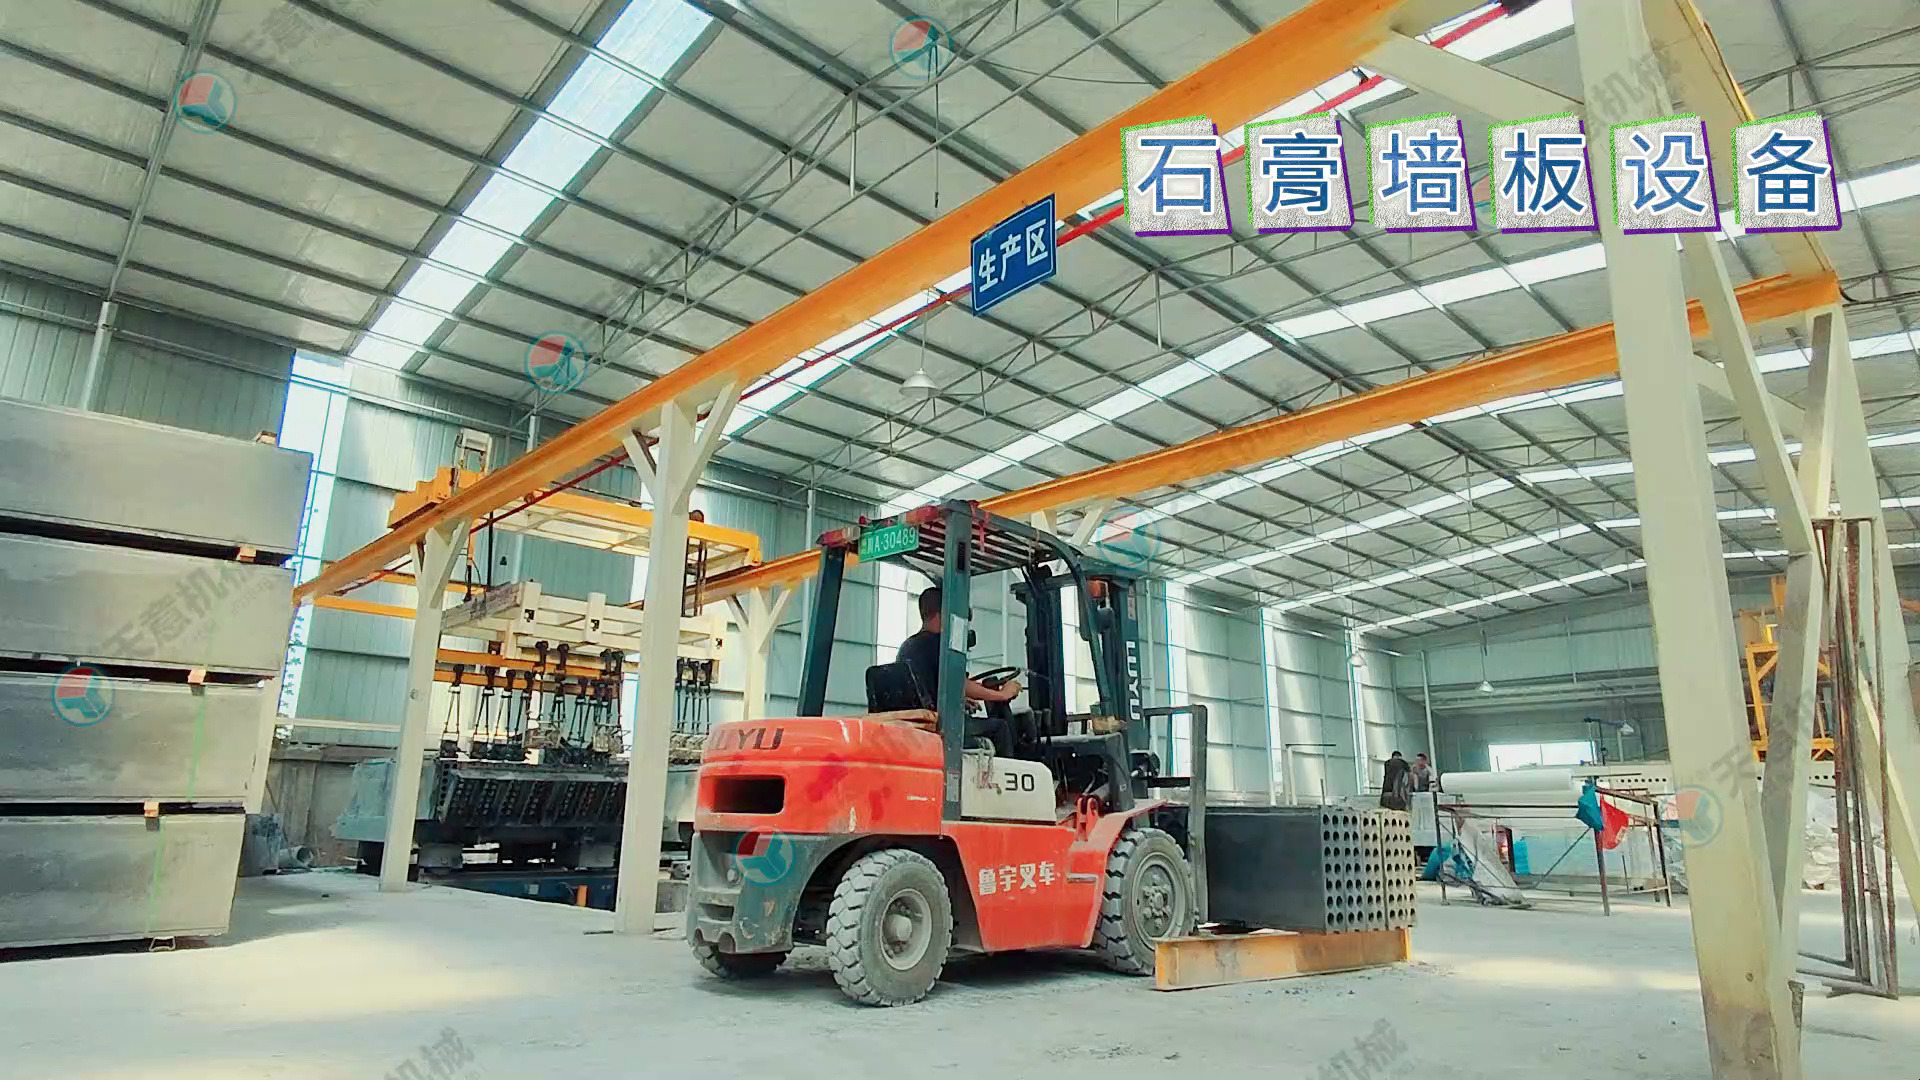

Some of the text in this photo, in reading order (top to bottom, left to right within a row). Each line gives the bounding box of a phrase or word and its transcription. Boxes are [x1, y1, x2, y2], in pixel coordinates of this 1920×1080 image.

[978, 218, 1049, 293] 生产区
[1125, 641, 1141, 720] LUYU
[1004, 772, 1035, 792] 30
[978, 860, 1056, 896] 鲁宇叉车
